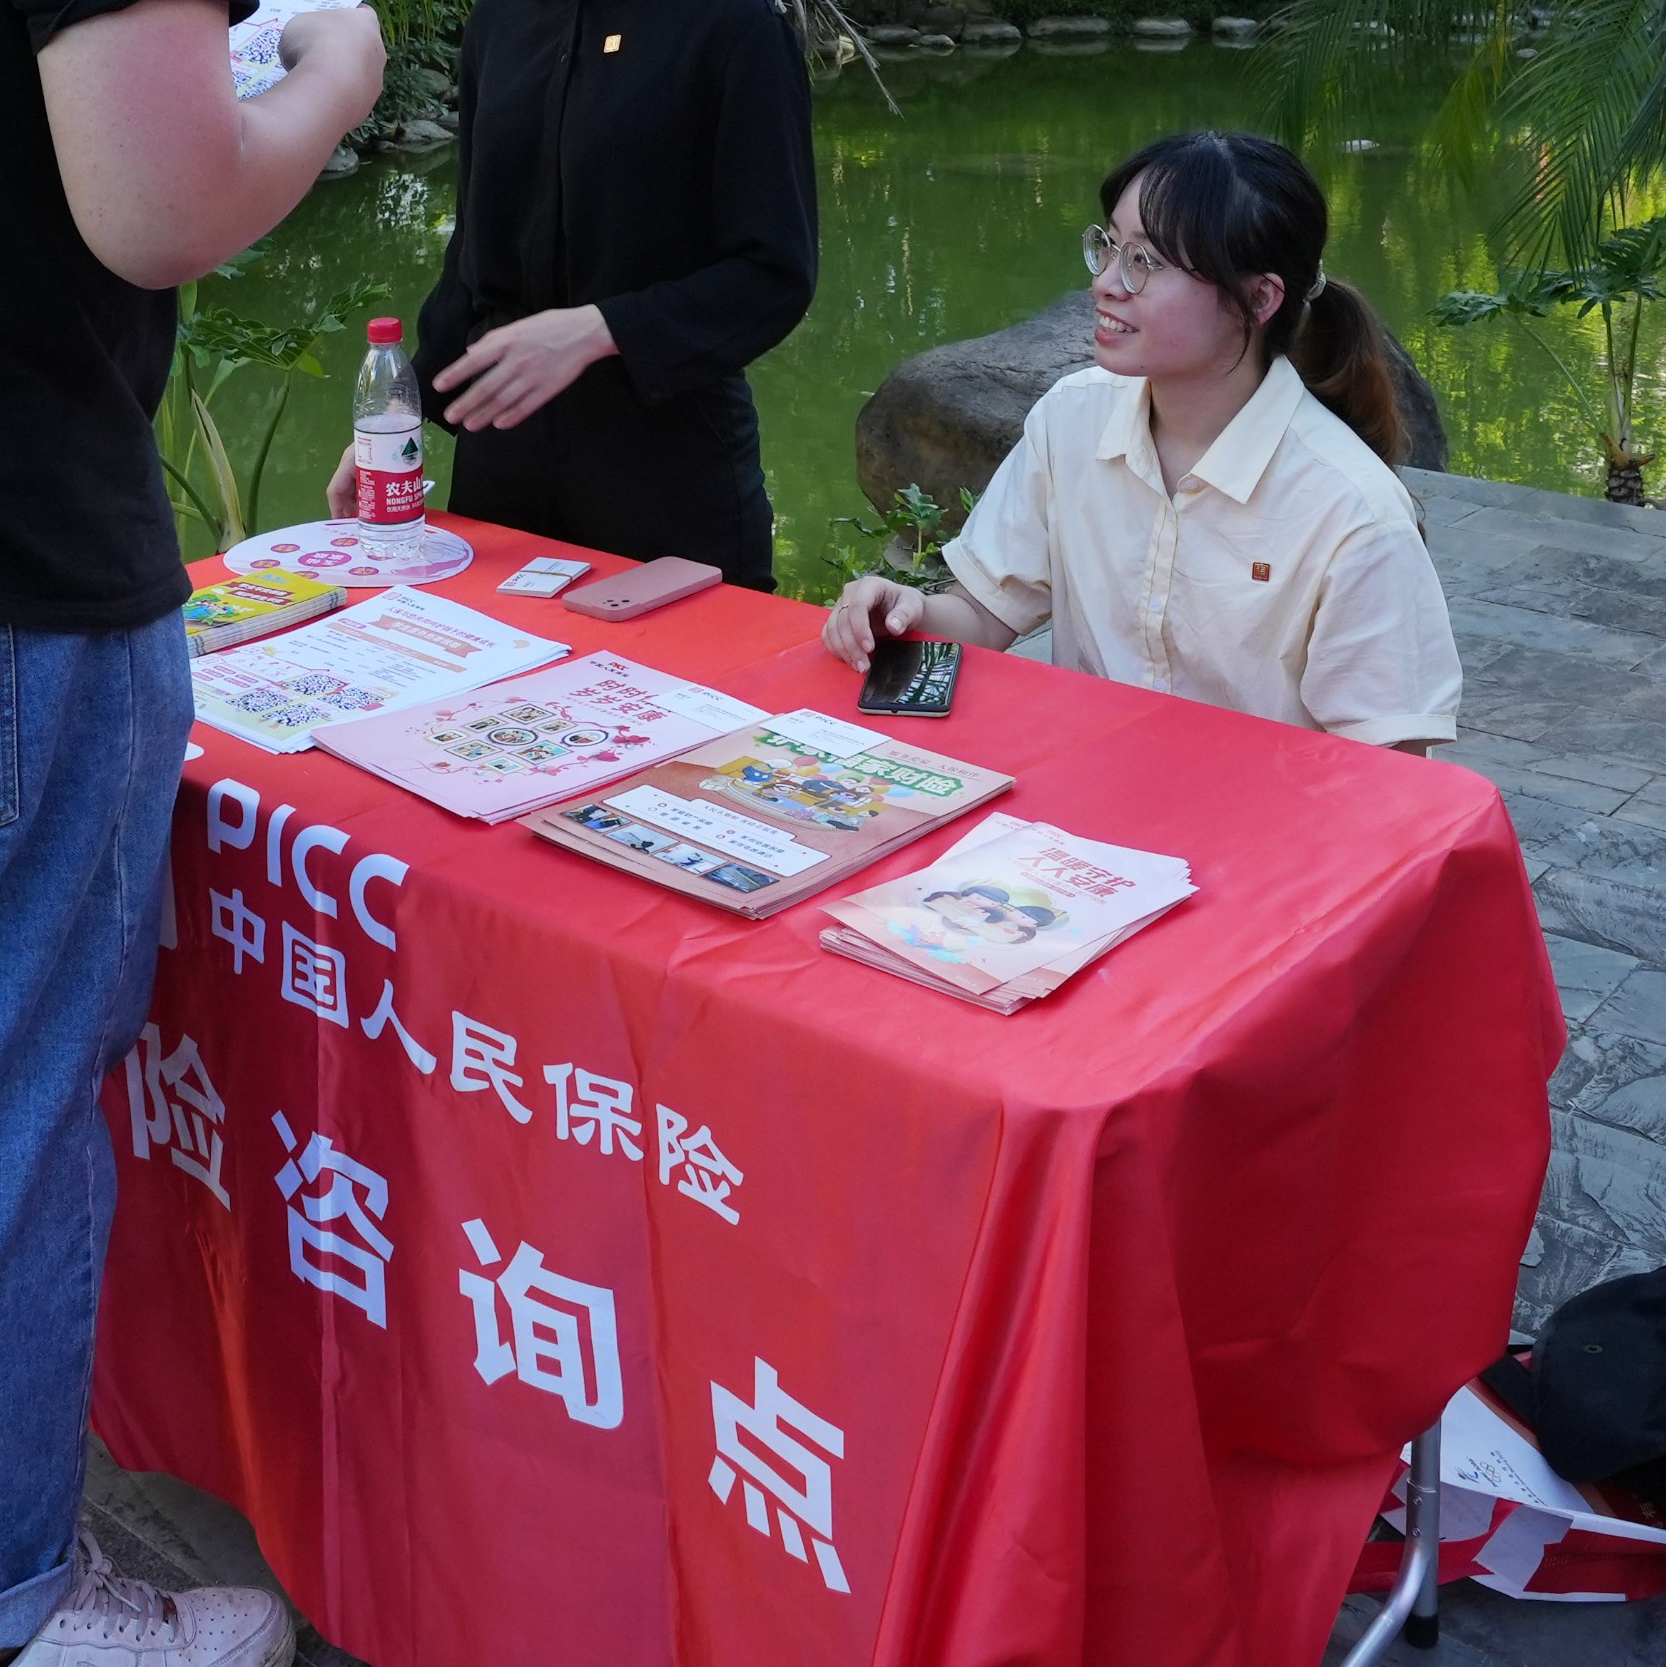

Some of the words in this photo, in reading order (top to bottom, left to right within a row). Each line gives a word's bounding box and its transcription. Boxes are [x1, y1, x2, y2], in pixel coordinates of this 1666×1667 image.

[385, 476, 423, 497] 农夫山
[595, 679, 659, 704] 时时
[208, 777, 409, 952] PICC
[209, 888, 744, 1226] 中国人民保险
[130, 1019, 851, 1594] 险咨询点
